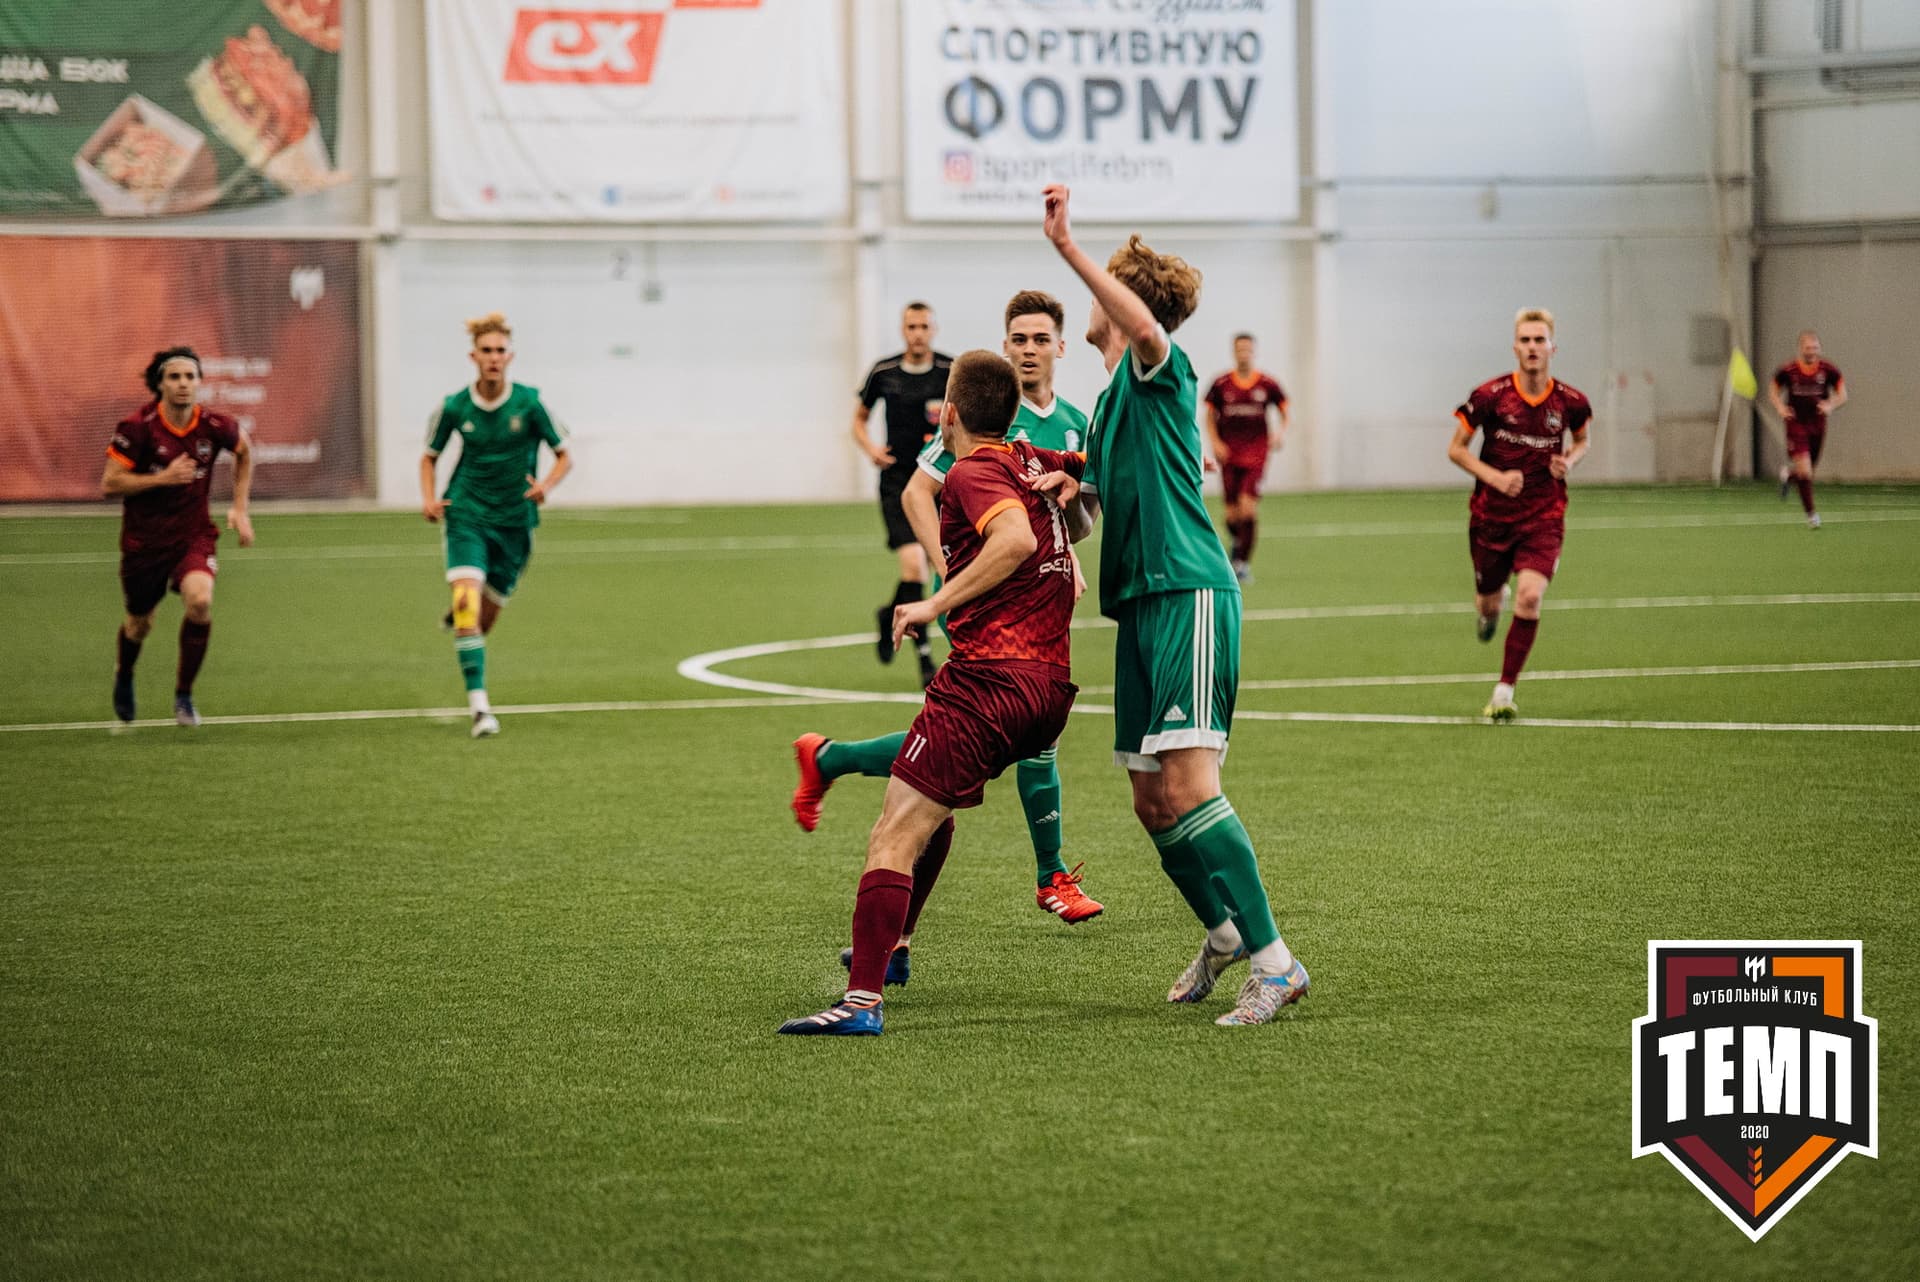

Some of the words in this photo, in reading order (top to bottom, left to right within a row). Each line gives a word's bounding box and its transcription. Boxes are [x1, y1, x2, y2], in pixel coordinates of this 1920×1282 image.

[942, 26, 1263, 65] СПОРТИВНУЮ
[943, 74, 1259, 142] ФОРМУ
[905, 733, 927, 762] 11
